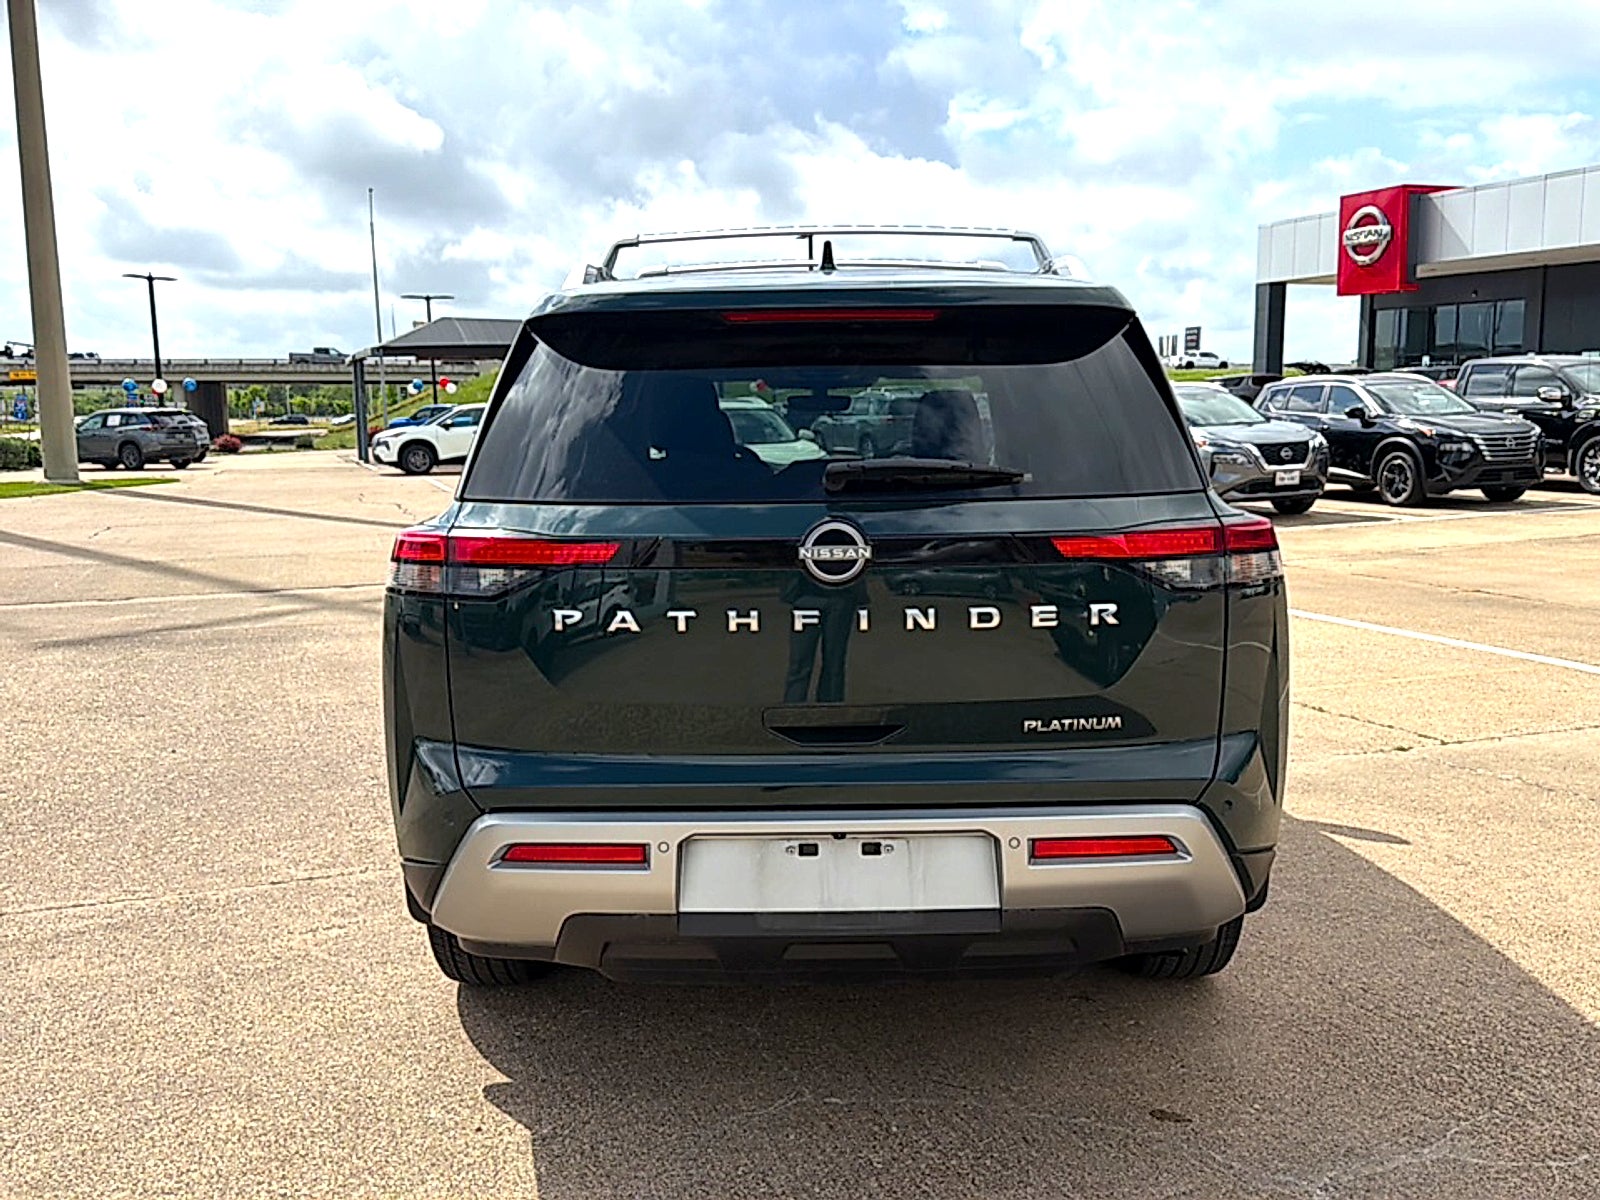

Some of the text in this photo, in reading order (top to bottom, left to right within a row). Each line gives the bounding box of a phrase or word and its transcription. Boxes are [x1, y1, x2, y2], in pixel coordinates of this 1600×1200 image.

[800, 547, 870, 559] NISSAN
[552, 603, 1120, 632] PATHFINDER
[1023, 716, 1122, 732] PLATINUM
